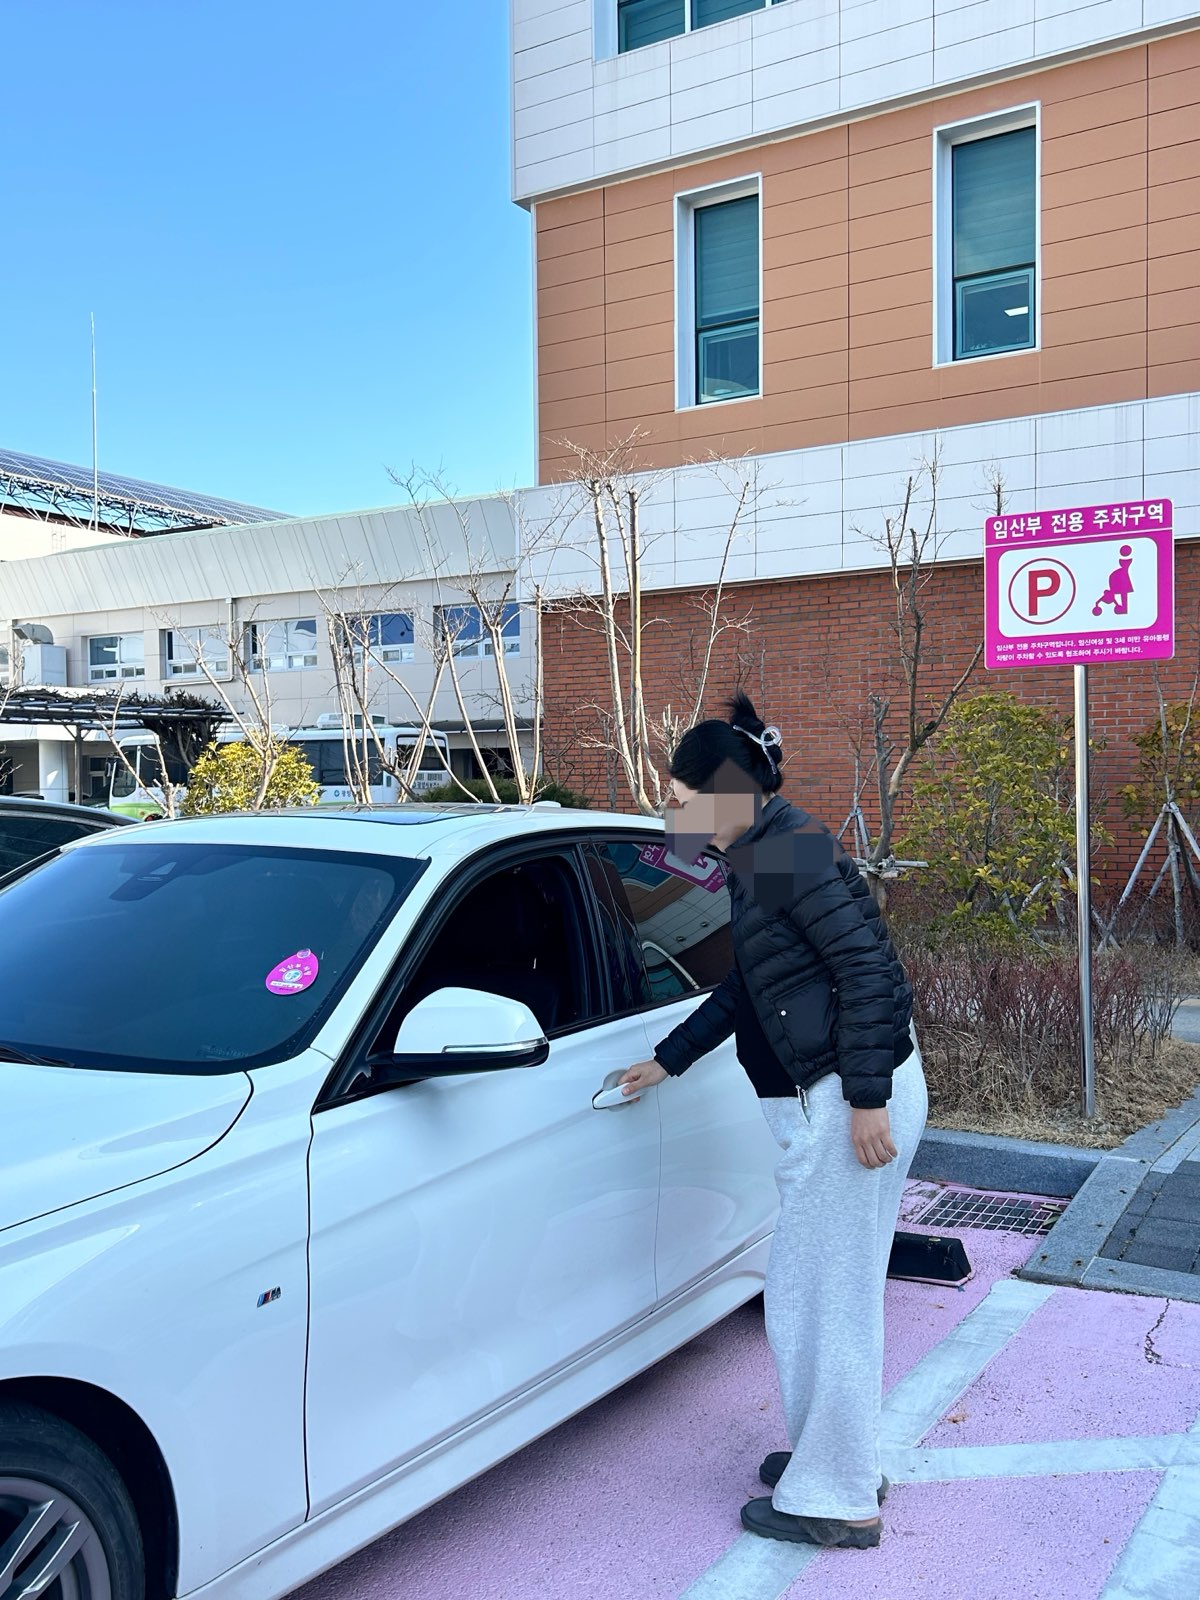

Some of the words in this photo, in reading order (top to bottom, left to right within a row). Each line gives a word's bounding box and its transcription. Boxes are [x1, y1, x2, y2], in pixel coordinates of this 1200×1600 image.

[993, 516, 1042, 540] 임산부
[1051, 512, 1084, 533] 전용
[1093, 503, 1163, 529] 주차구역
[1028, 568, 1061, 616] P
[996, 644, 1014, 652] 임산부
[1030, 640, 1076, 649] 주차구역입니다.
[1078, 638, 1104, 647] 임신여성
[1105, 637, 1113, 645] 및
[1114, 636, 1126, 644] 3세
[996, 653, 1014, 662] 차량이
[1016, 652, 1035, 661] 주차할
[1036, 651, 1043, 659] 수
[1045, 650, 1064, 659] 있도록
[1066, 648, 1091, 658] 협조하여
[1093, 647, 1113, 656] 주시기
[1114, 646, 1143, 655] 바랍니다.
